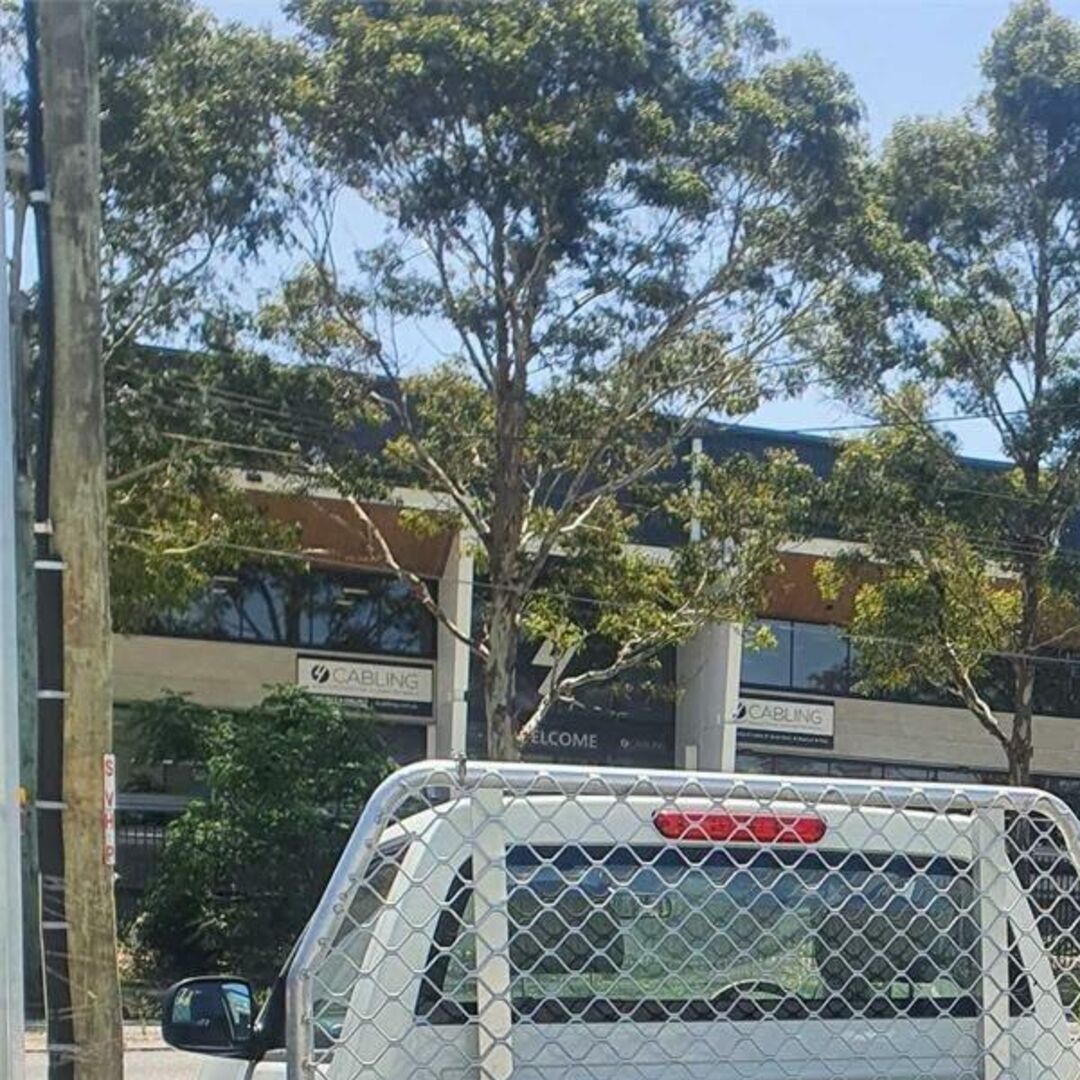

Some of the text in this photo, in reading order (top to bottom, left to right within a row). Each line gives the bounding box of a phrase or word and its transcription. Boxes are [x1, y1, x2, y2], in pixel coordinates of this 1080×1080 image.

[332, 667, 419, 690] CABLING
[748, 704, 823, 725] CABLING
[530, 729, 598, 749] ELCOME
